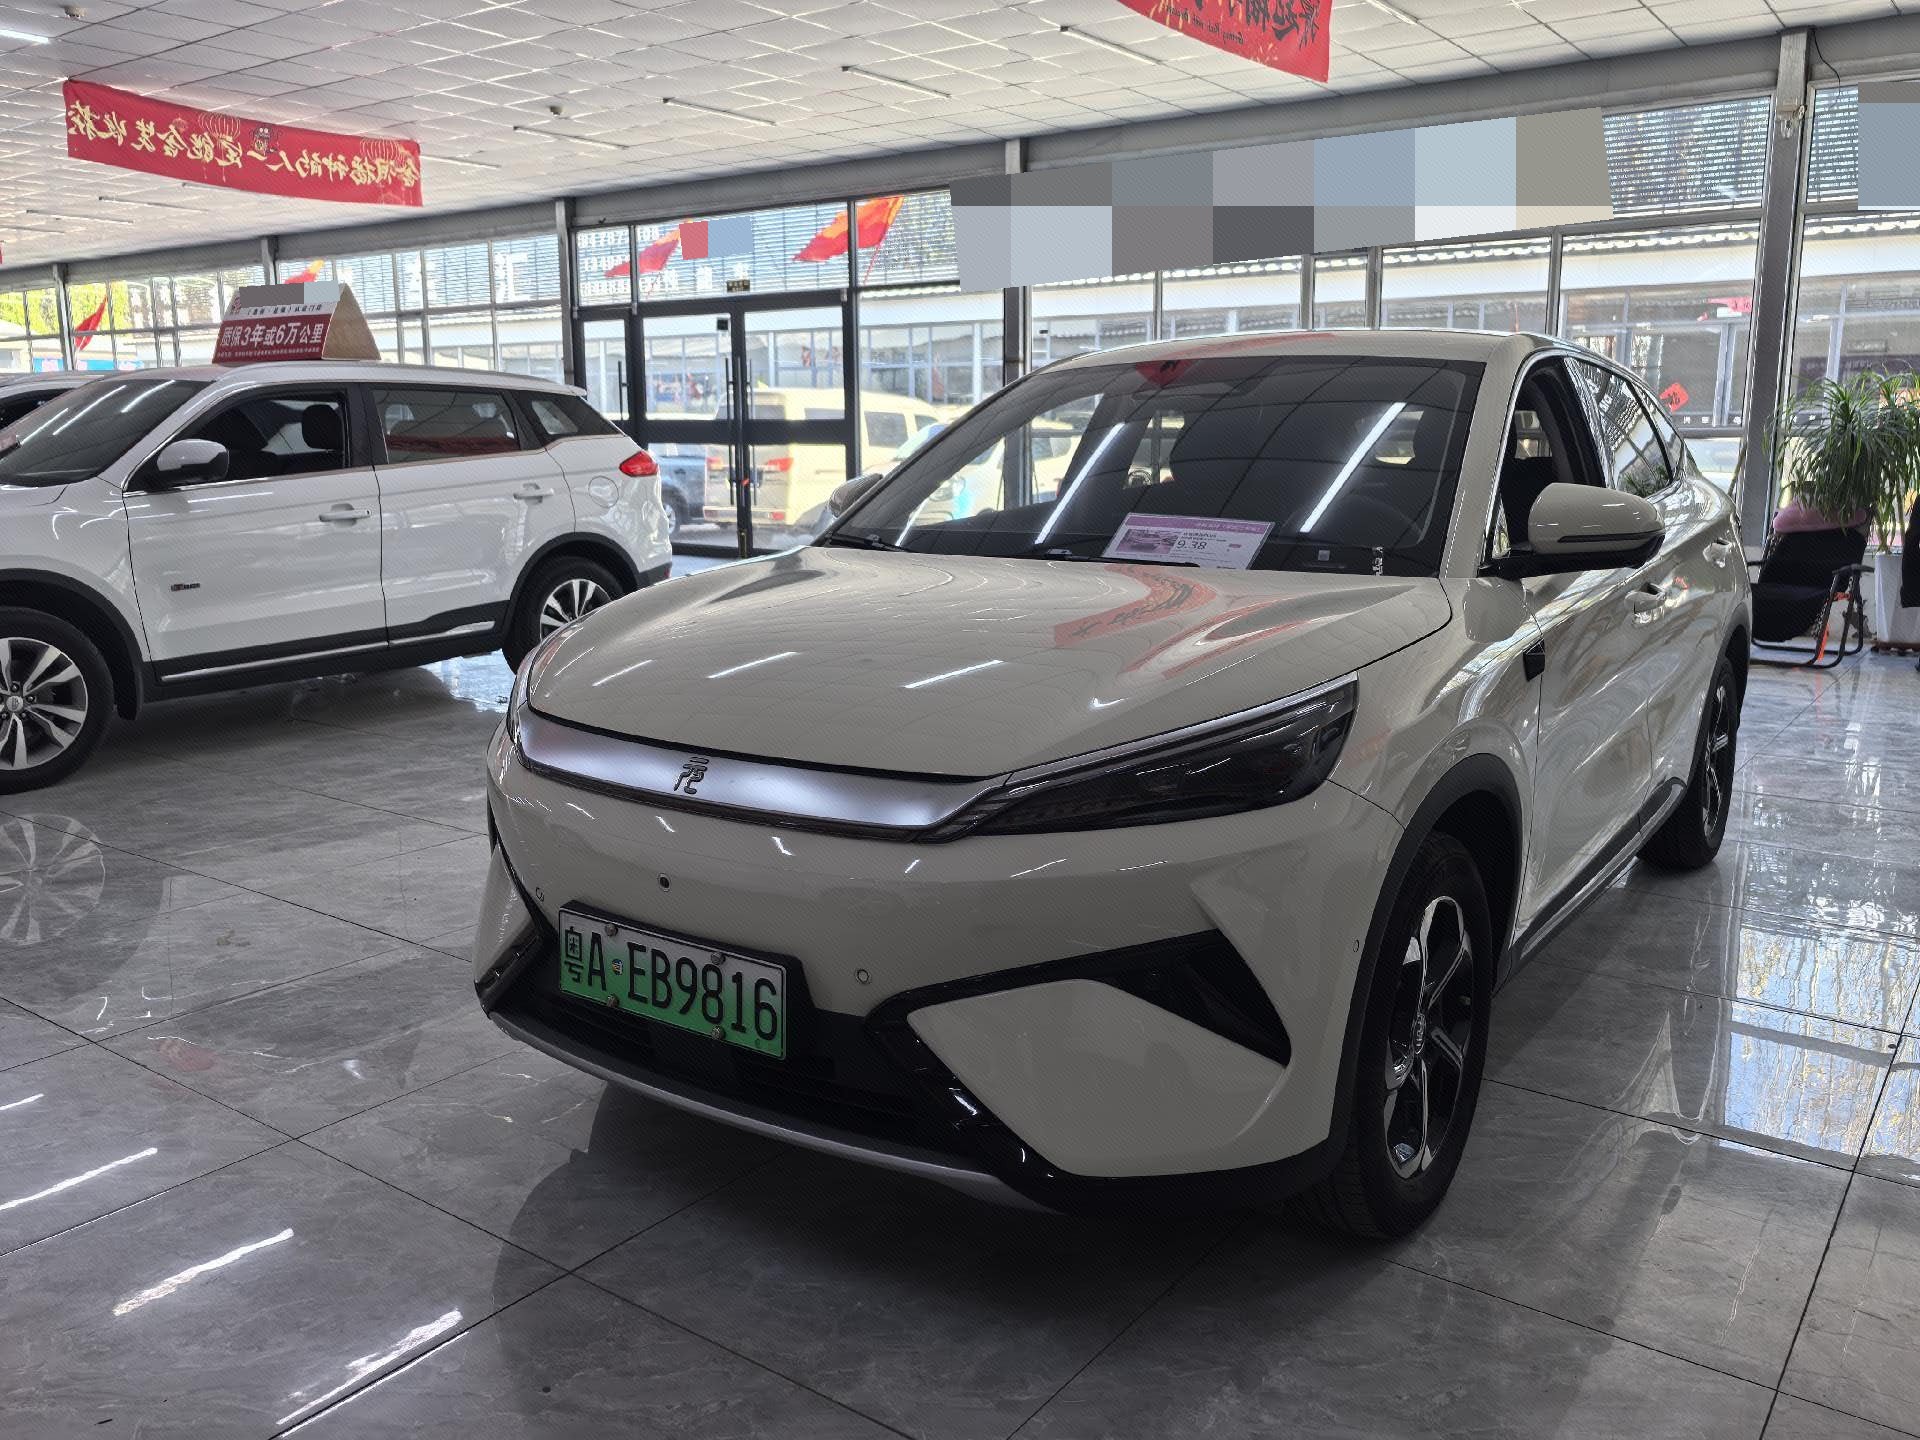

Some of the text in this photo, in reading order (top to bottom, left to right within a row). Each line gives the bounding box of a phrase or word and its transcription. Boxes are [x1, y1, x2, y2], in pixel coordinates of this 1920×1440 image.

[220, 322, 324, 347] 质保3年或6万公里
[1176, 540, 1208, 550] 9.38
[564, 926, 778, 1041] 粤A EB9816
